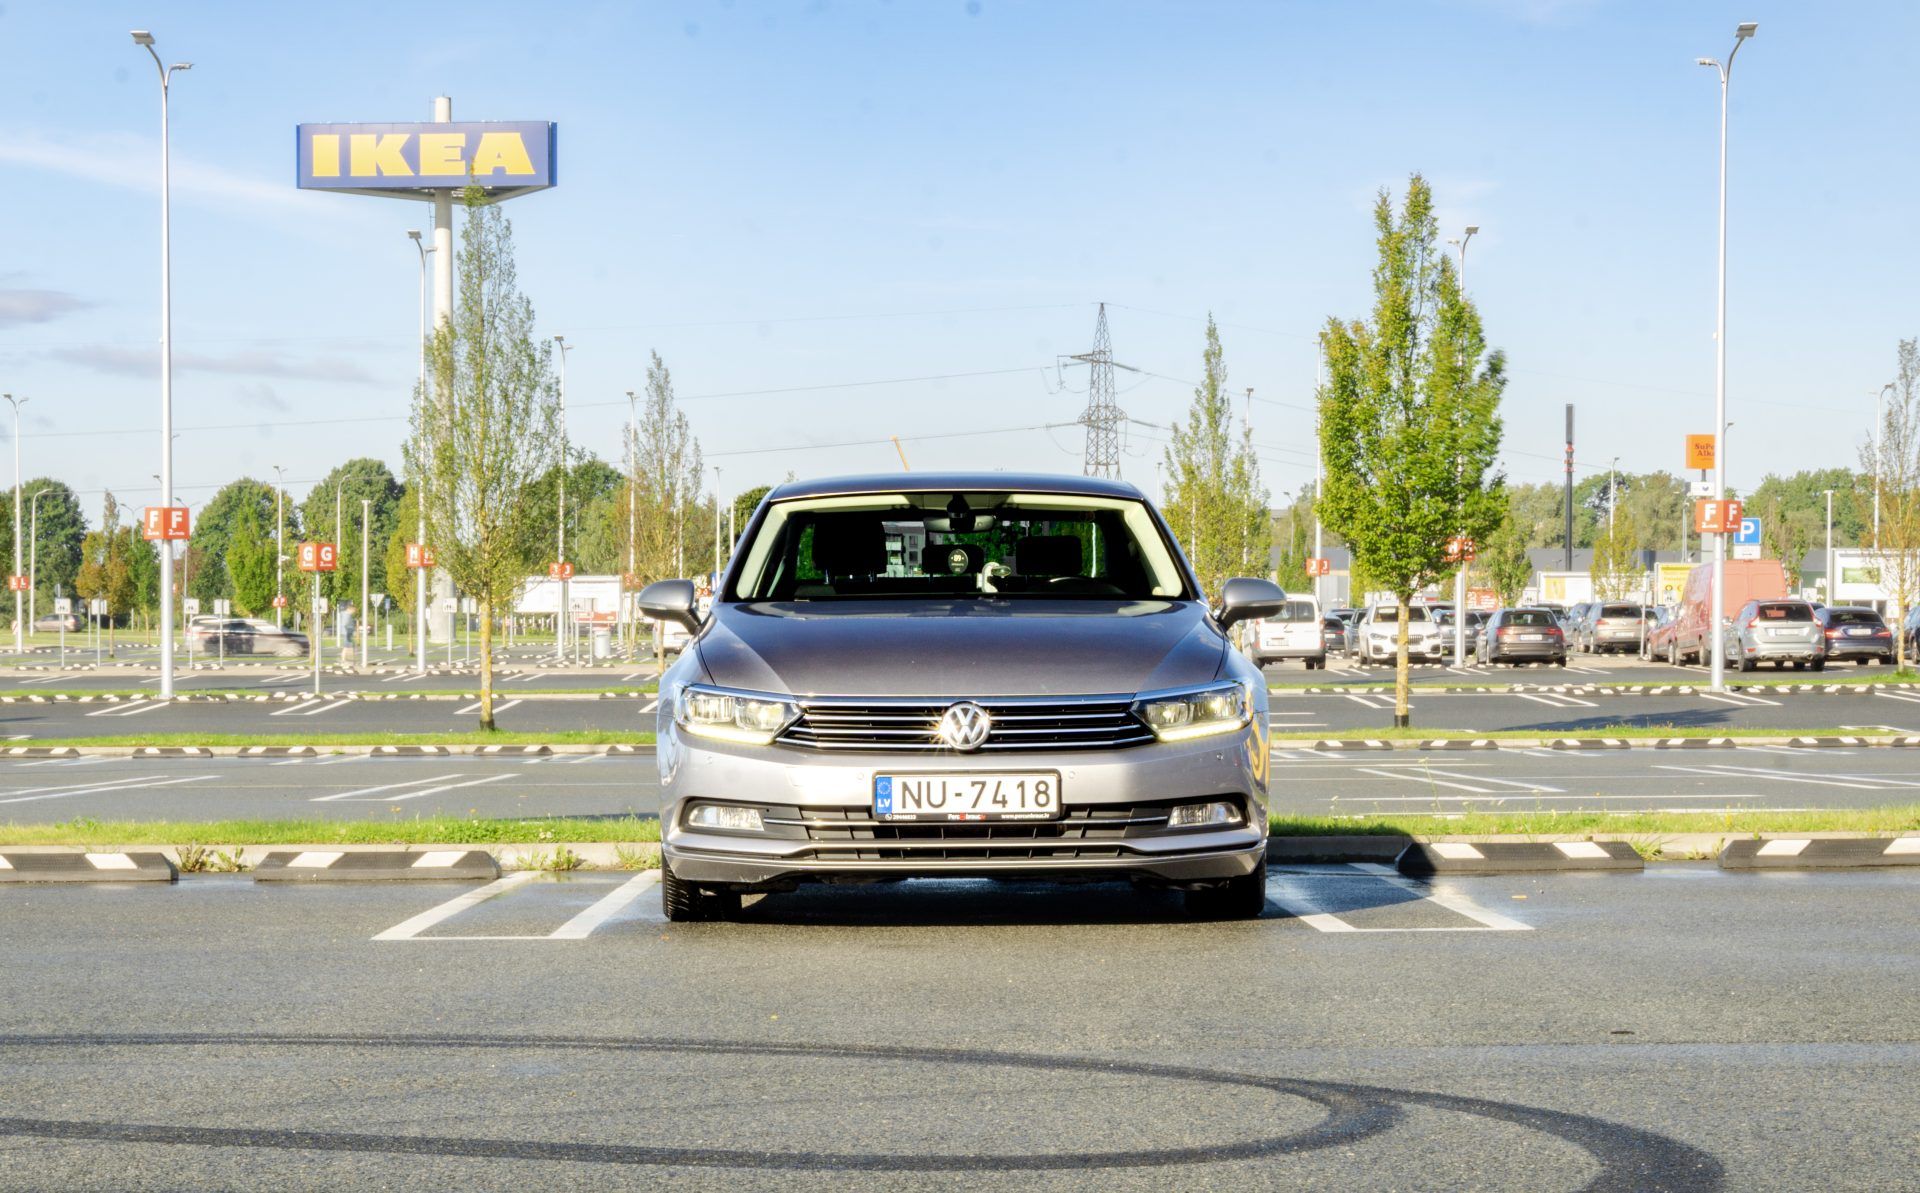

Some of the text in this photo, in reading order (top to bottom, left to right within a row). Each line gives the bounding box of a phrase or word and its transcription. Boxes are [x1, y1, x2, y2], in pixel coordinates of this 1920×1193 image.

[312, 132, 536, 177] IKEA
[149, 510, 159, 529] F
[171, 510, 183, 529] F
[1704, 503, 1717, 521] F
[1728, 503, 1738, 521] F
[1740, 521, 1755, 541] P
[303, 545, 313, 561] G
[320, 545, 333, 561] G
[877, 798, 891, 809] LV
[901, 780, 1051, 809] NU-7418
